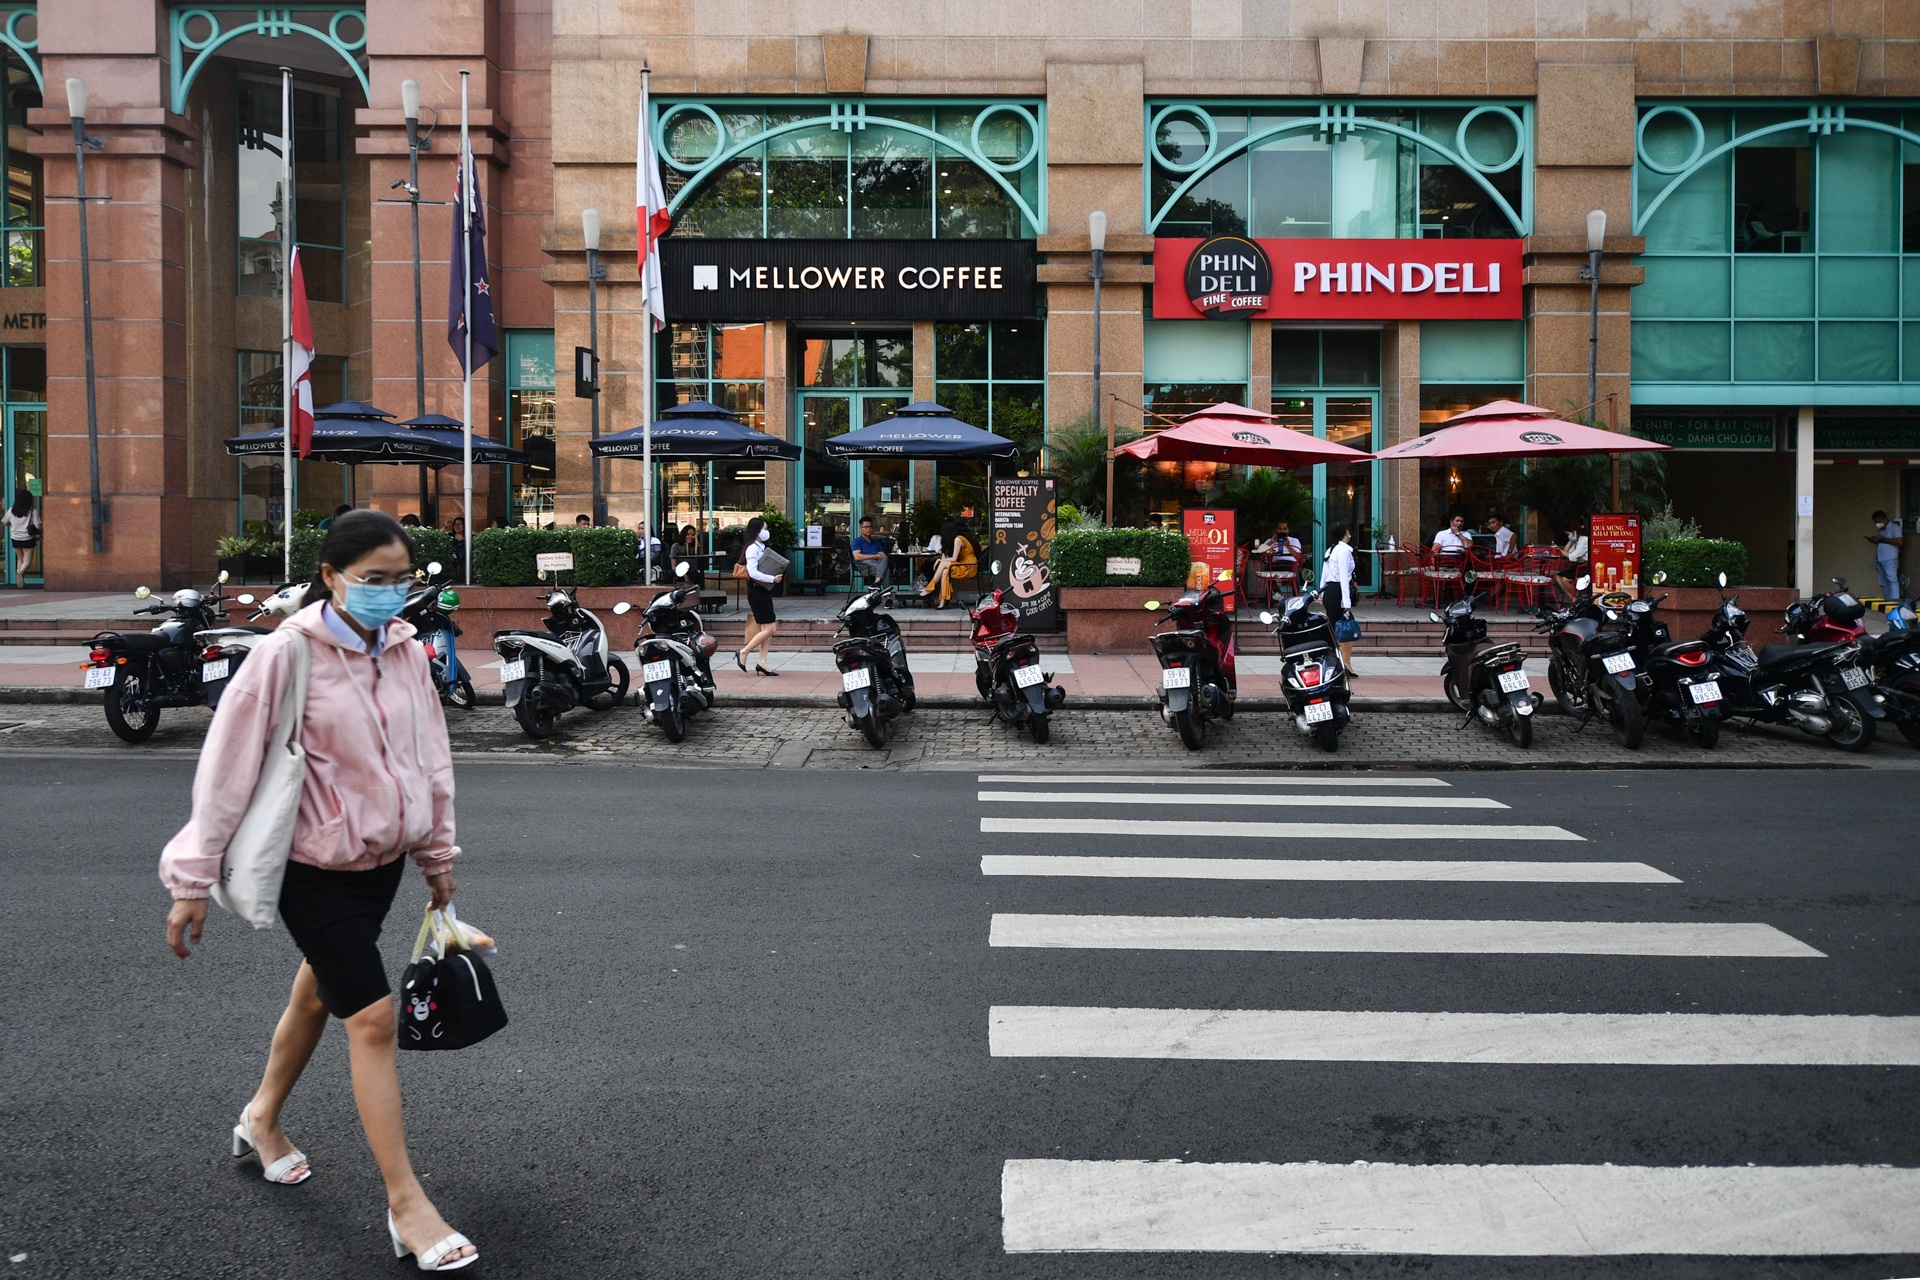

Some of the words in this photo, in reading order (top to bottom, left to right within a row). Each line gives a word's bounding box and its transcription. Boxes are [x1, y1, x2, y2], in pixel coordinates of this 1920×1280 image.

[1200, 254, 1257, 271] PHIN
[729, 266, 885, 290] MELLOWER
[898, 266, 1003, 290] COFFEE
[1200, 275, 1257, 292] DELI
[1293, 262, 1501, 294] PHINDELI
[1203, 294, 1227, 307] FINE
[1231, 296, 1263, 308] COFFEE
[1646, 420, 1674, 430] ENTRY
[1688, 420, 1708, 430] FOR
[1715, 420, 1736, 431] EXIT
[1743, 420, 1771, 431] ONLY
[880, 432, 962, 440] MELLOWER
[1717, 433, 1738, 444] CHO
[650, 442, 671, 451] OFFEE
[876, 445, 904, 453] COFFEE
[995, 485, 1039, 496] SPECIALTY
[995, 497, 1026, 508] COFFEE
[1188, 528, 1208, 536] MUA
[1207, 528, 1229, 545] 01
[1025, 606, 1039, 617] GOOD
[1607, 654, 1628, 665] 61-C2
[647, 661, 666, 673] 59-T1
[1018, 666, 1037, 678] 59-S2
[91, 668, 112, 679] 59-A3
[646, 669, 669, 681] 648.71
[846, 670, 865, 682] 71-B3
[1167, 669, 1186, 679] 59-V2
[1502, 671, 1522, 683] 59-B1
[87, 676, 112, 688] 296.73
[1503, 679, 1528, 692] 694.80
[1693, 683, 1715, 694] 59-D2
[1307, 703, 1327, 714] 59-C1
